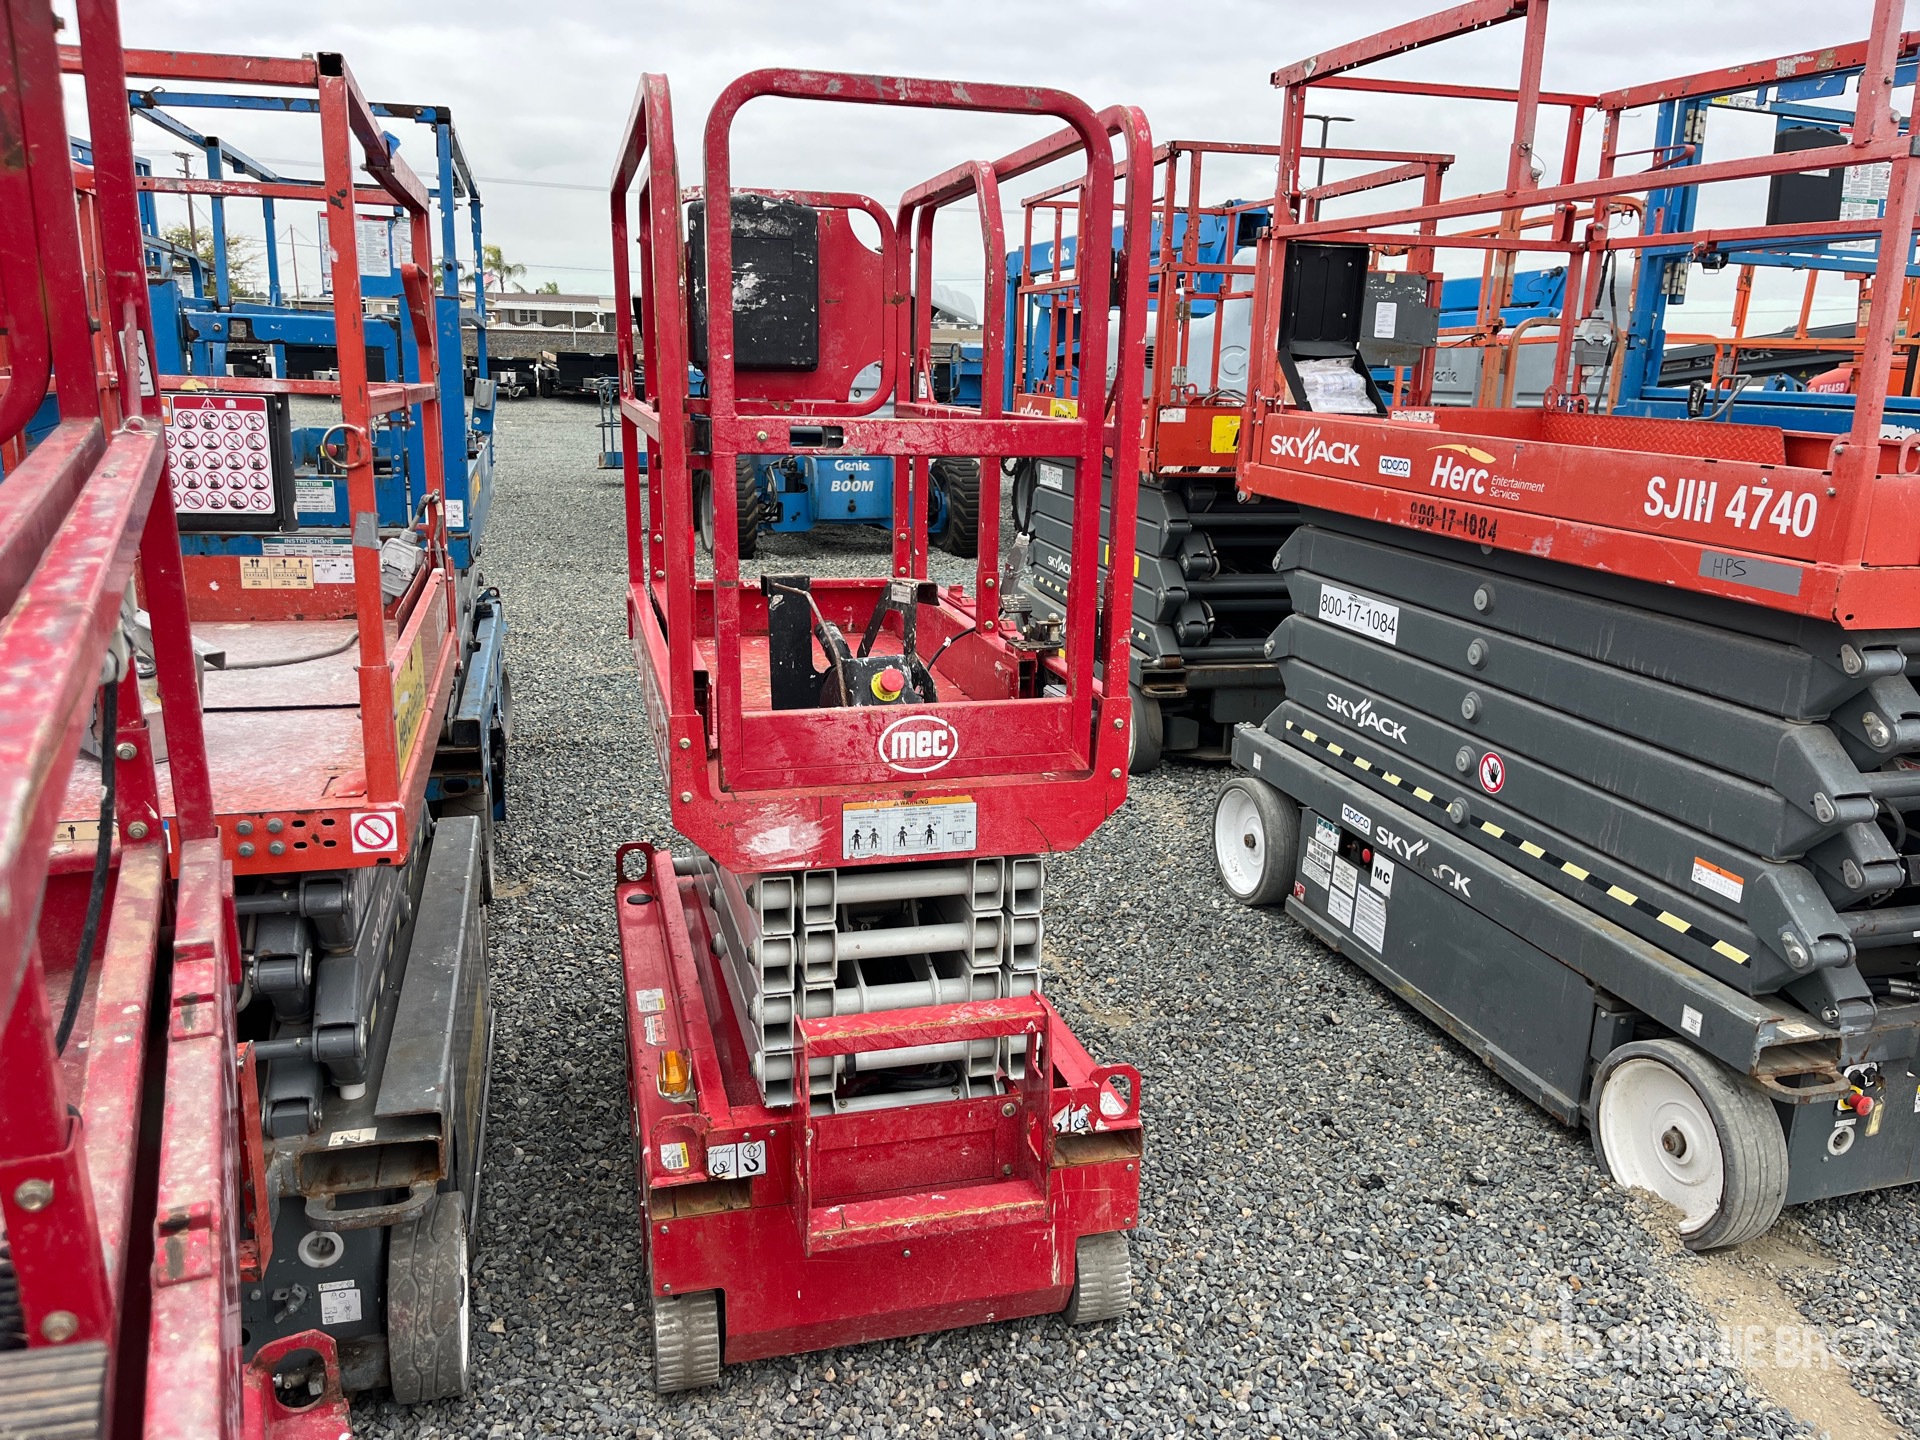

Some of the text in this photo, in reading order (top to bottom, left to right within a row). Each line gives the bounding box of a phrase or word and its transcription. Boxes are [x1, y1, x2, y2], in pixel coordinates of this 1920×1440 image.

[1048, 244, 1070, 264] Gie
[1694, 349, 1773, 367] SKACK
[1434, 367, 1457, 383] enie
[1270, 426, 1360, 467] SKYJACK
[834, 459, 870, 472] Genie
[1430, 455, 1489, 494] Herc
[831, 480, 874, 492] BOOM
[1489, 486, 1520, 501] Services
[1491, 475, 1546, 493] Entertainment
[1725, 485, 1817, 537] 4740
[1712, 558, 1747, 577] HPS
[1321, 594, 1395, 635] 800-17-1084
[1327, 693, 1407, 744] SKYJACK
[1376, 826, 1472, 898] SKYCK
[1374, 866, 1390, 885] MC
